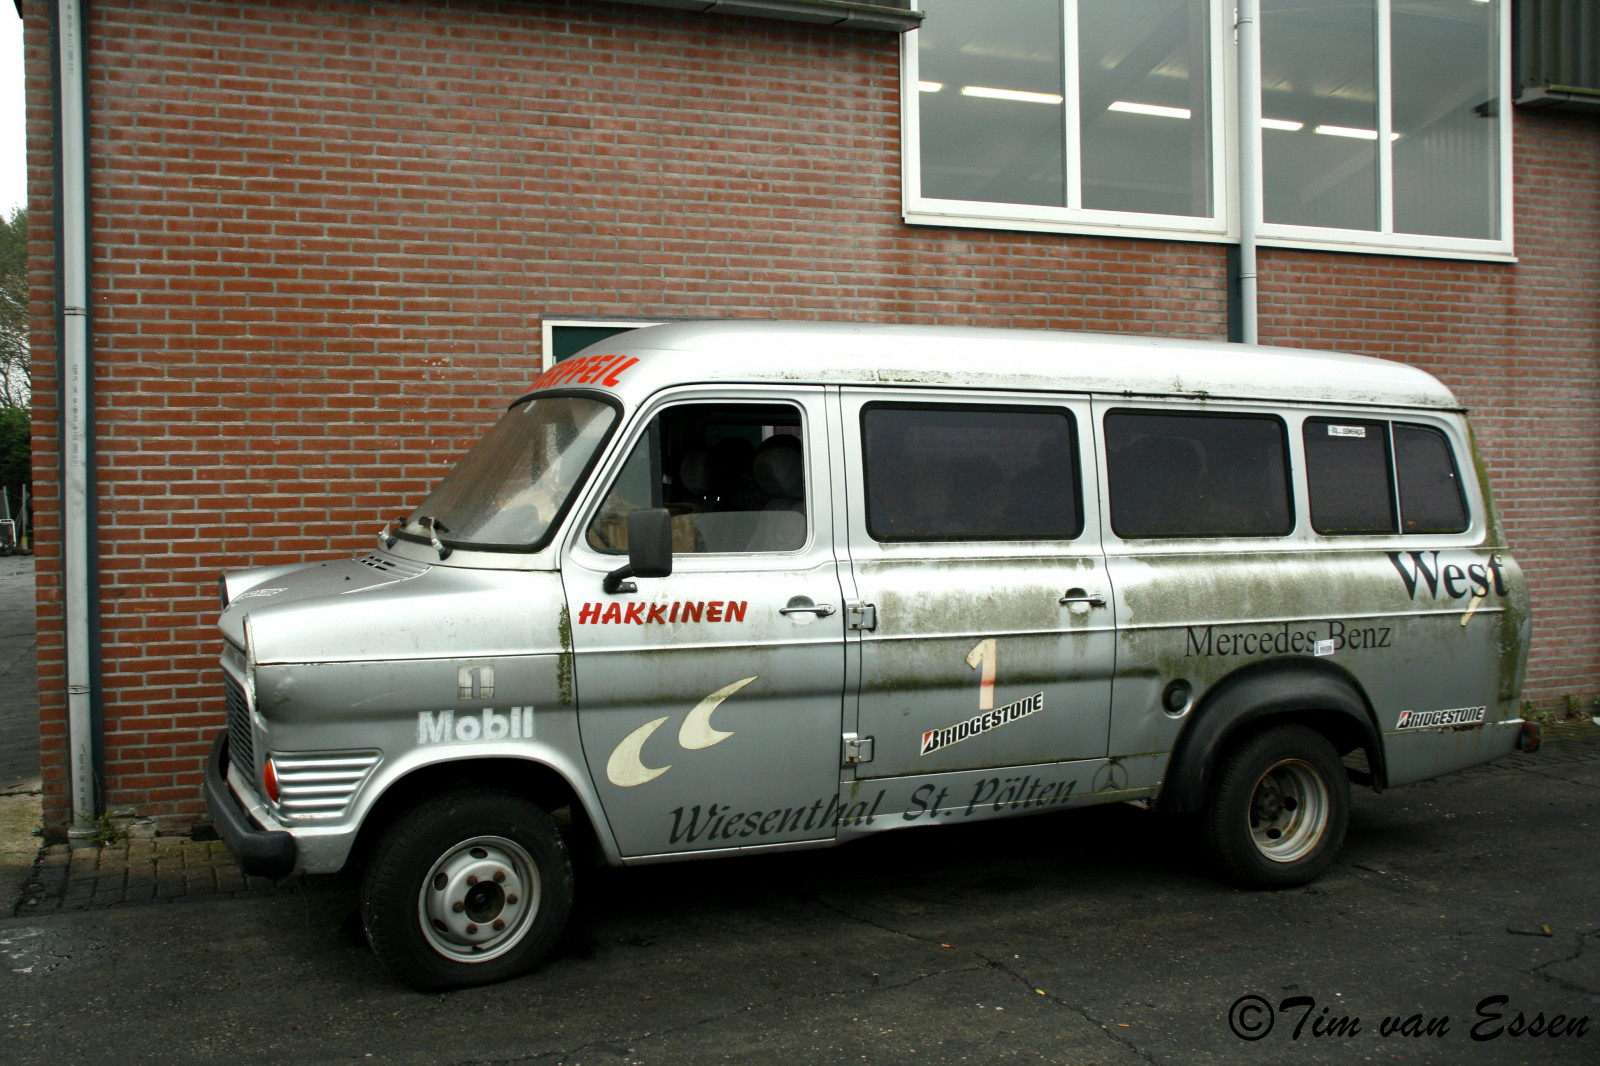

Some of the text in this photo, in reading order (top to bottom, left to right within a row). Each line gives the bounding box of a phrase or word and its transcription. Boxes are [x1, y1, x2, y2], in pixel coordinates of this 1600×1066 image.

[1386, 551, 1508, 600] West
[579, 601, 748, 625] HAKKINEN
[1185, 623, 1317, 657] Mercedes
[1327, 619, 1392, 651] Benz
[965, 638, 997, 710] 1
[921, 692, 1044, 757] BRIDGESTONE
[1397, 706, 1486, 730] BRIDGESTONE
[669, 777, 1077, 844] Wiesenthal St. Pölten
